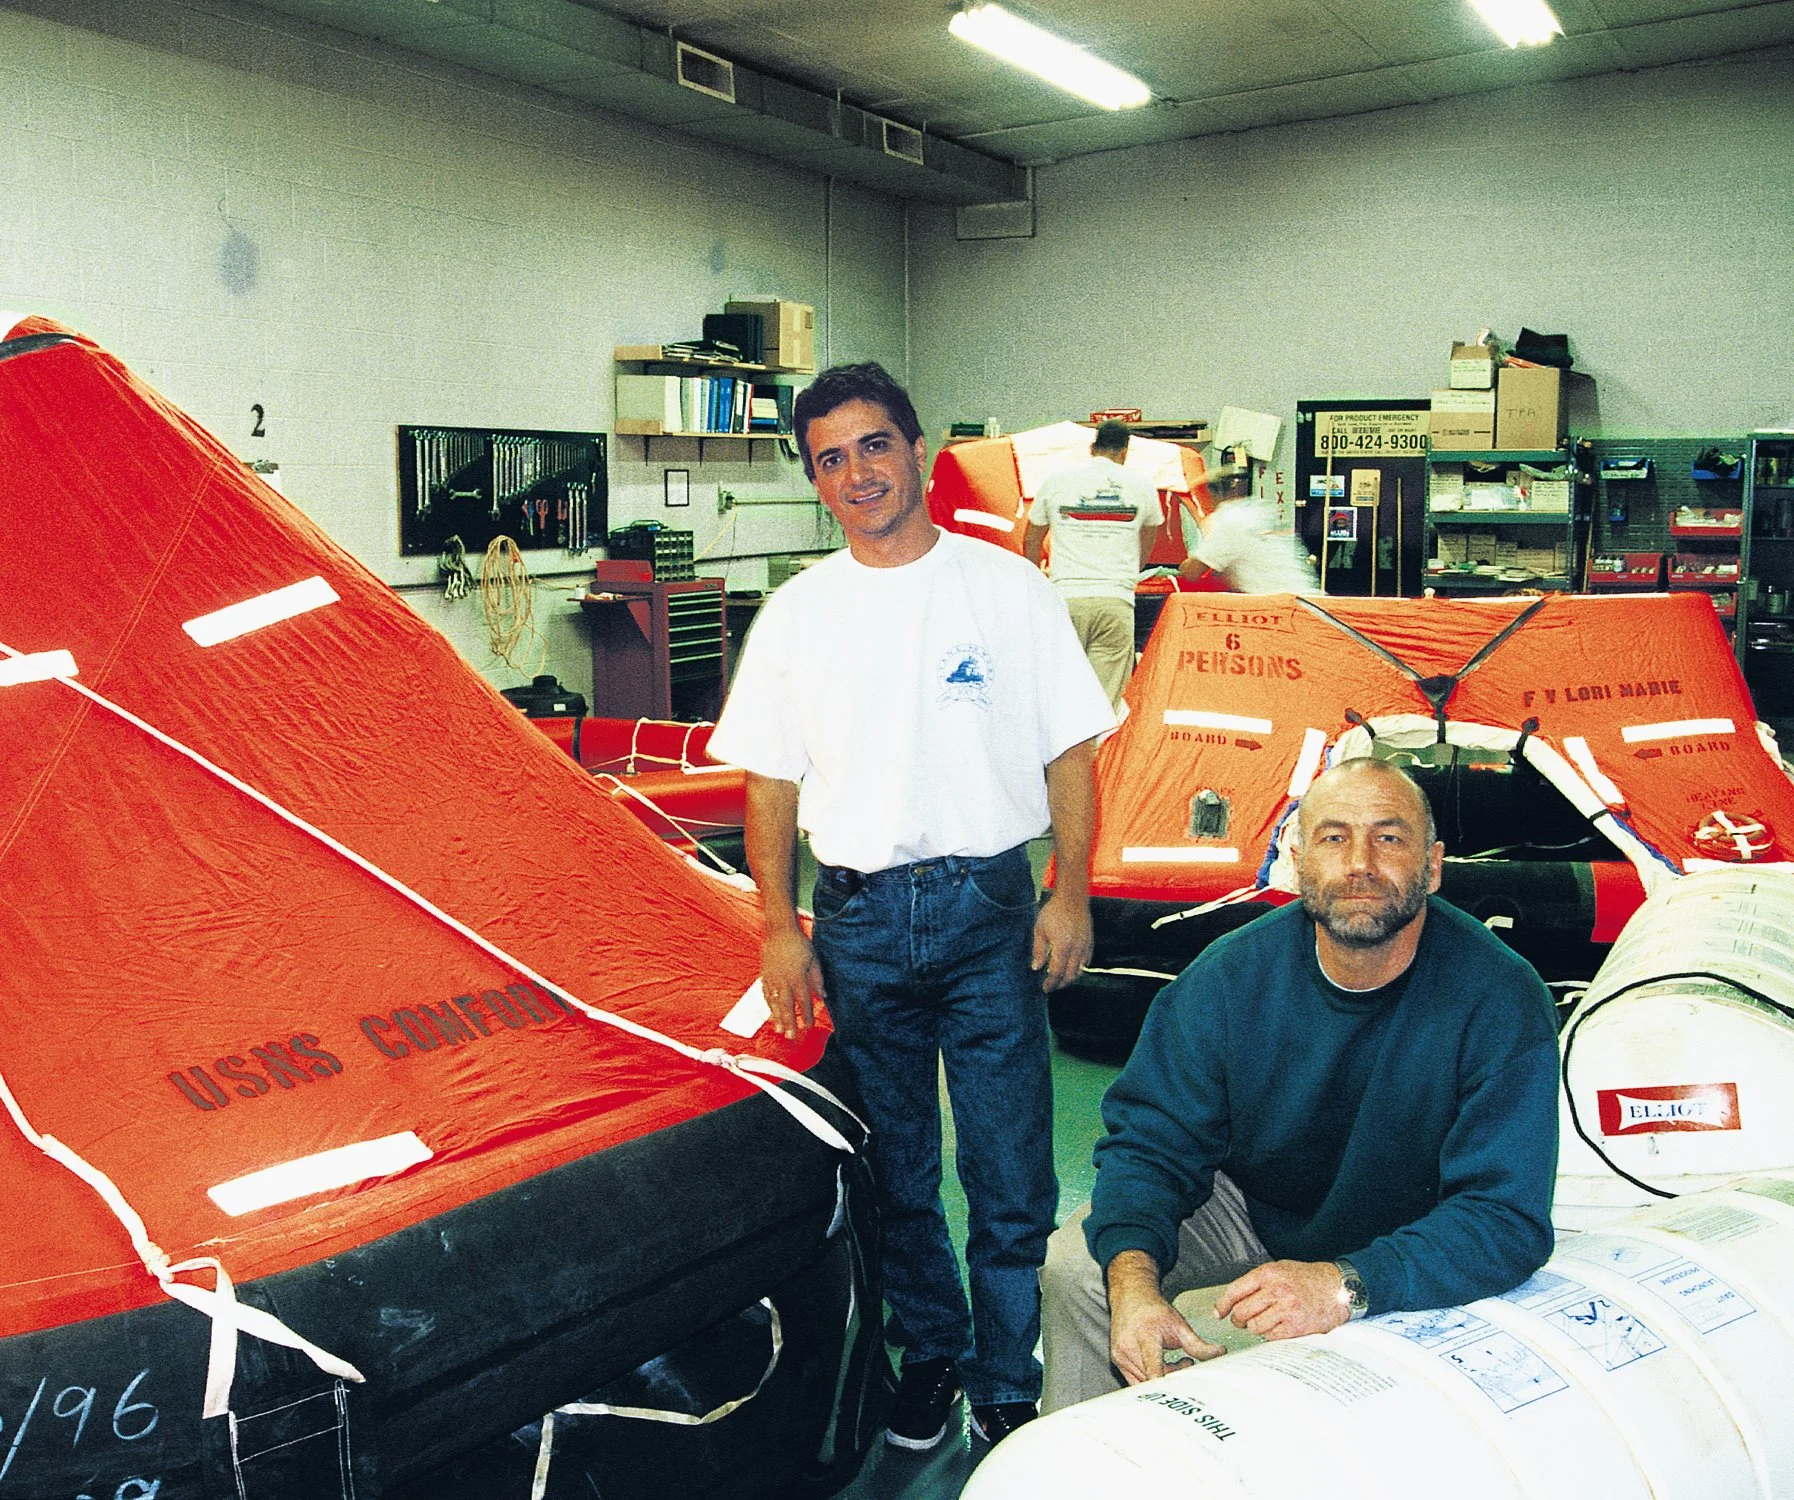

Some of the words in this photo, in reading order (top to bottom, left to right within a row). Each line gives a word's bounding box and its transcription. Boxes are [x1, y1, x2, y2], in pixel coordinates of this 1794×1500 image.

[251, 403, 265, 437] 2
[1330, 414, 1344, 422] FOR
[1320, 434, 1428, 449] 800-424-9300
[1196, 612, 1283, 625] ELLIOT
[1225, 633, 1241, 650] 6
[1177, 651, 1303, 680] PERSONS
[1524, 691, 1535, 708] F
[1565, 684, 1612, 702] LORI
[1618, 680, 1682, 698] MARIE
[1170, 731, 1227, 745] BOARD
[1669, 741, 1731, 756] BOARD
[167, 1033, 344, 1111] USNS
[1629, 1102, 1707, 1119] ELLIOT
[1158, 1396, 1203, 1416] SIDE
[0, 1368, 159, 1481] /96
[1193, 1414, 1237, 1442] THIS
